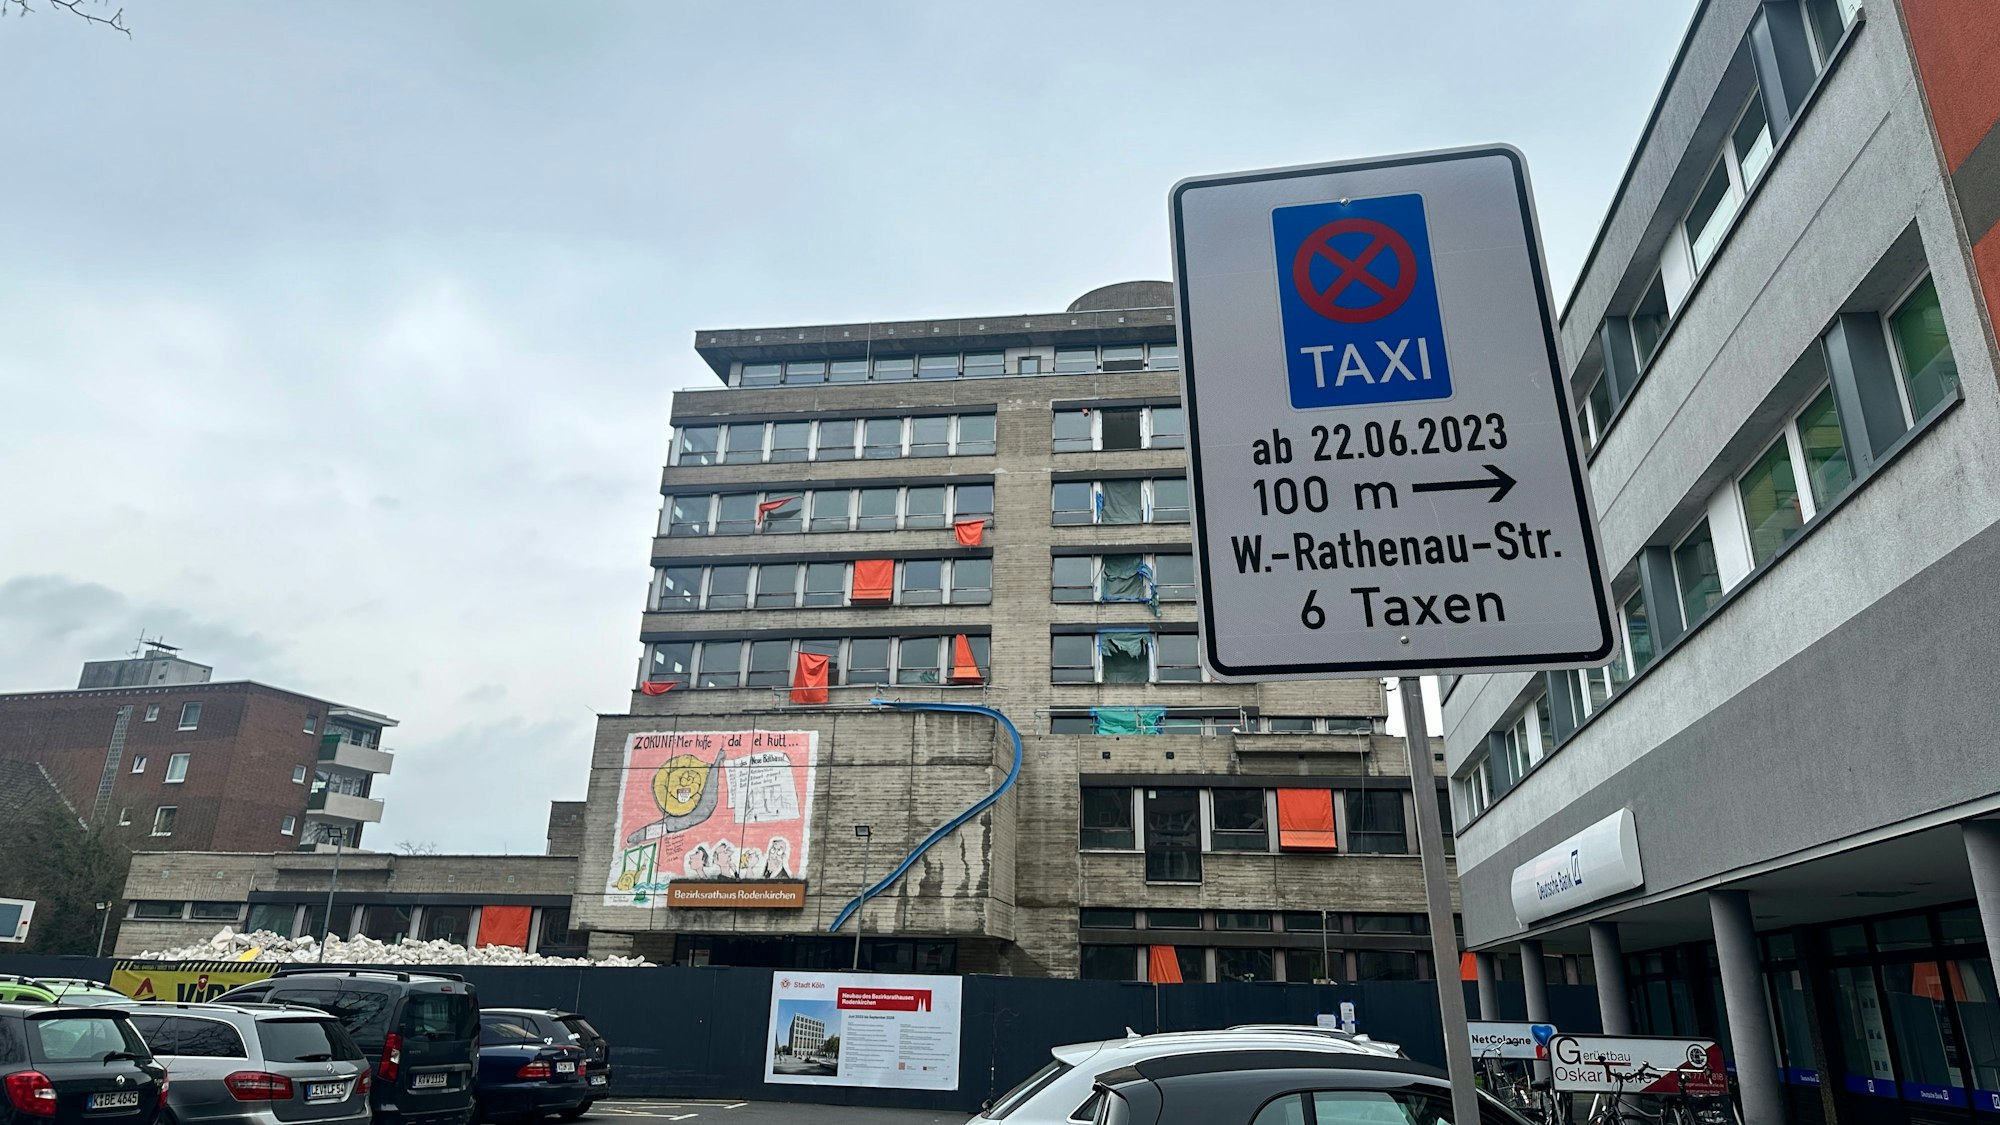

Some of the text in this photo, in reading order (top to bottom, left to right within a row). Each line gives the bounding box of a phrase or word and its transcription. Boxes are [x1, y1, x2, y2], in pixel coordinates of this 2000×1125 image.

[1300, 338, 1432, 388] TAXI
[1253, 413, 1508, 465] ab 22.06.2023
[1253, 476, 1398, 516] 100 m
[1231, 521, 1562, 574] W.-Rathenau-Str.
[1300, 587, 1506, 630] 6 Taxen
[677, 735, 692, 748] Mer
[696, 735, 712, 750] hoffe
[1537, 868, 1574, 900] Deutsche Bank
[674, 889, 796, 900] Bezirksrathaus Rodenkirchen
[794, 981, 810, 989] Stadt
[871, 993, 914, 1001] Bezirksrathauses
[1471, 1034, 1532, 1047] NetCologne
[1554, 1067, 1603, 1083] Oskar
[93, 1092, 137, 1107] K BE 4645
